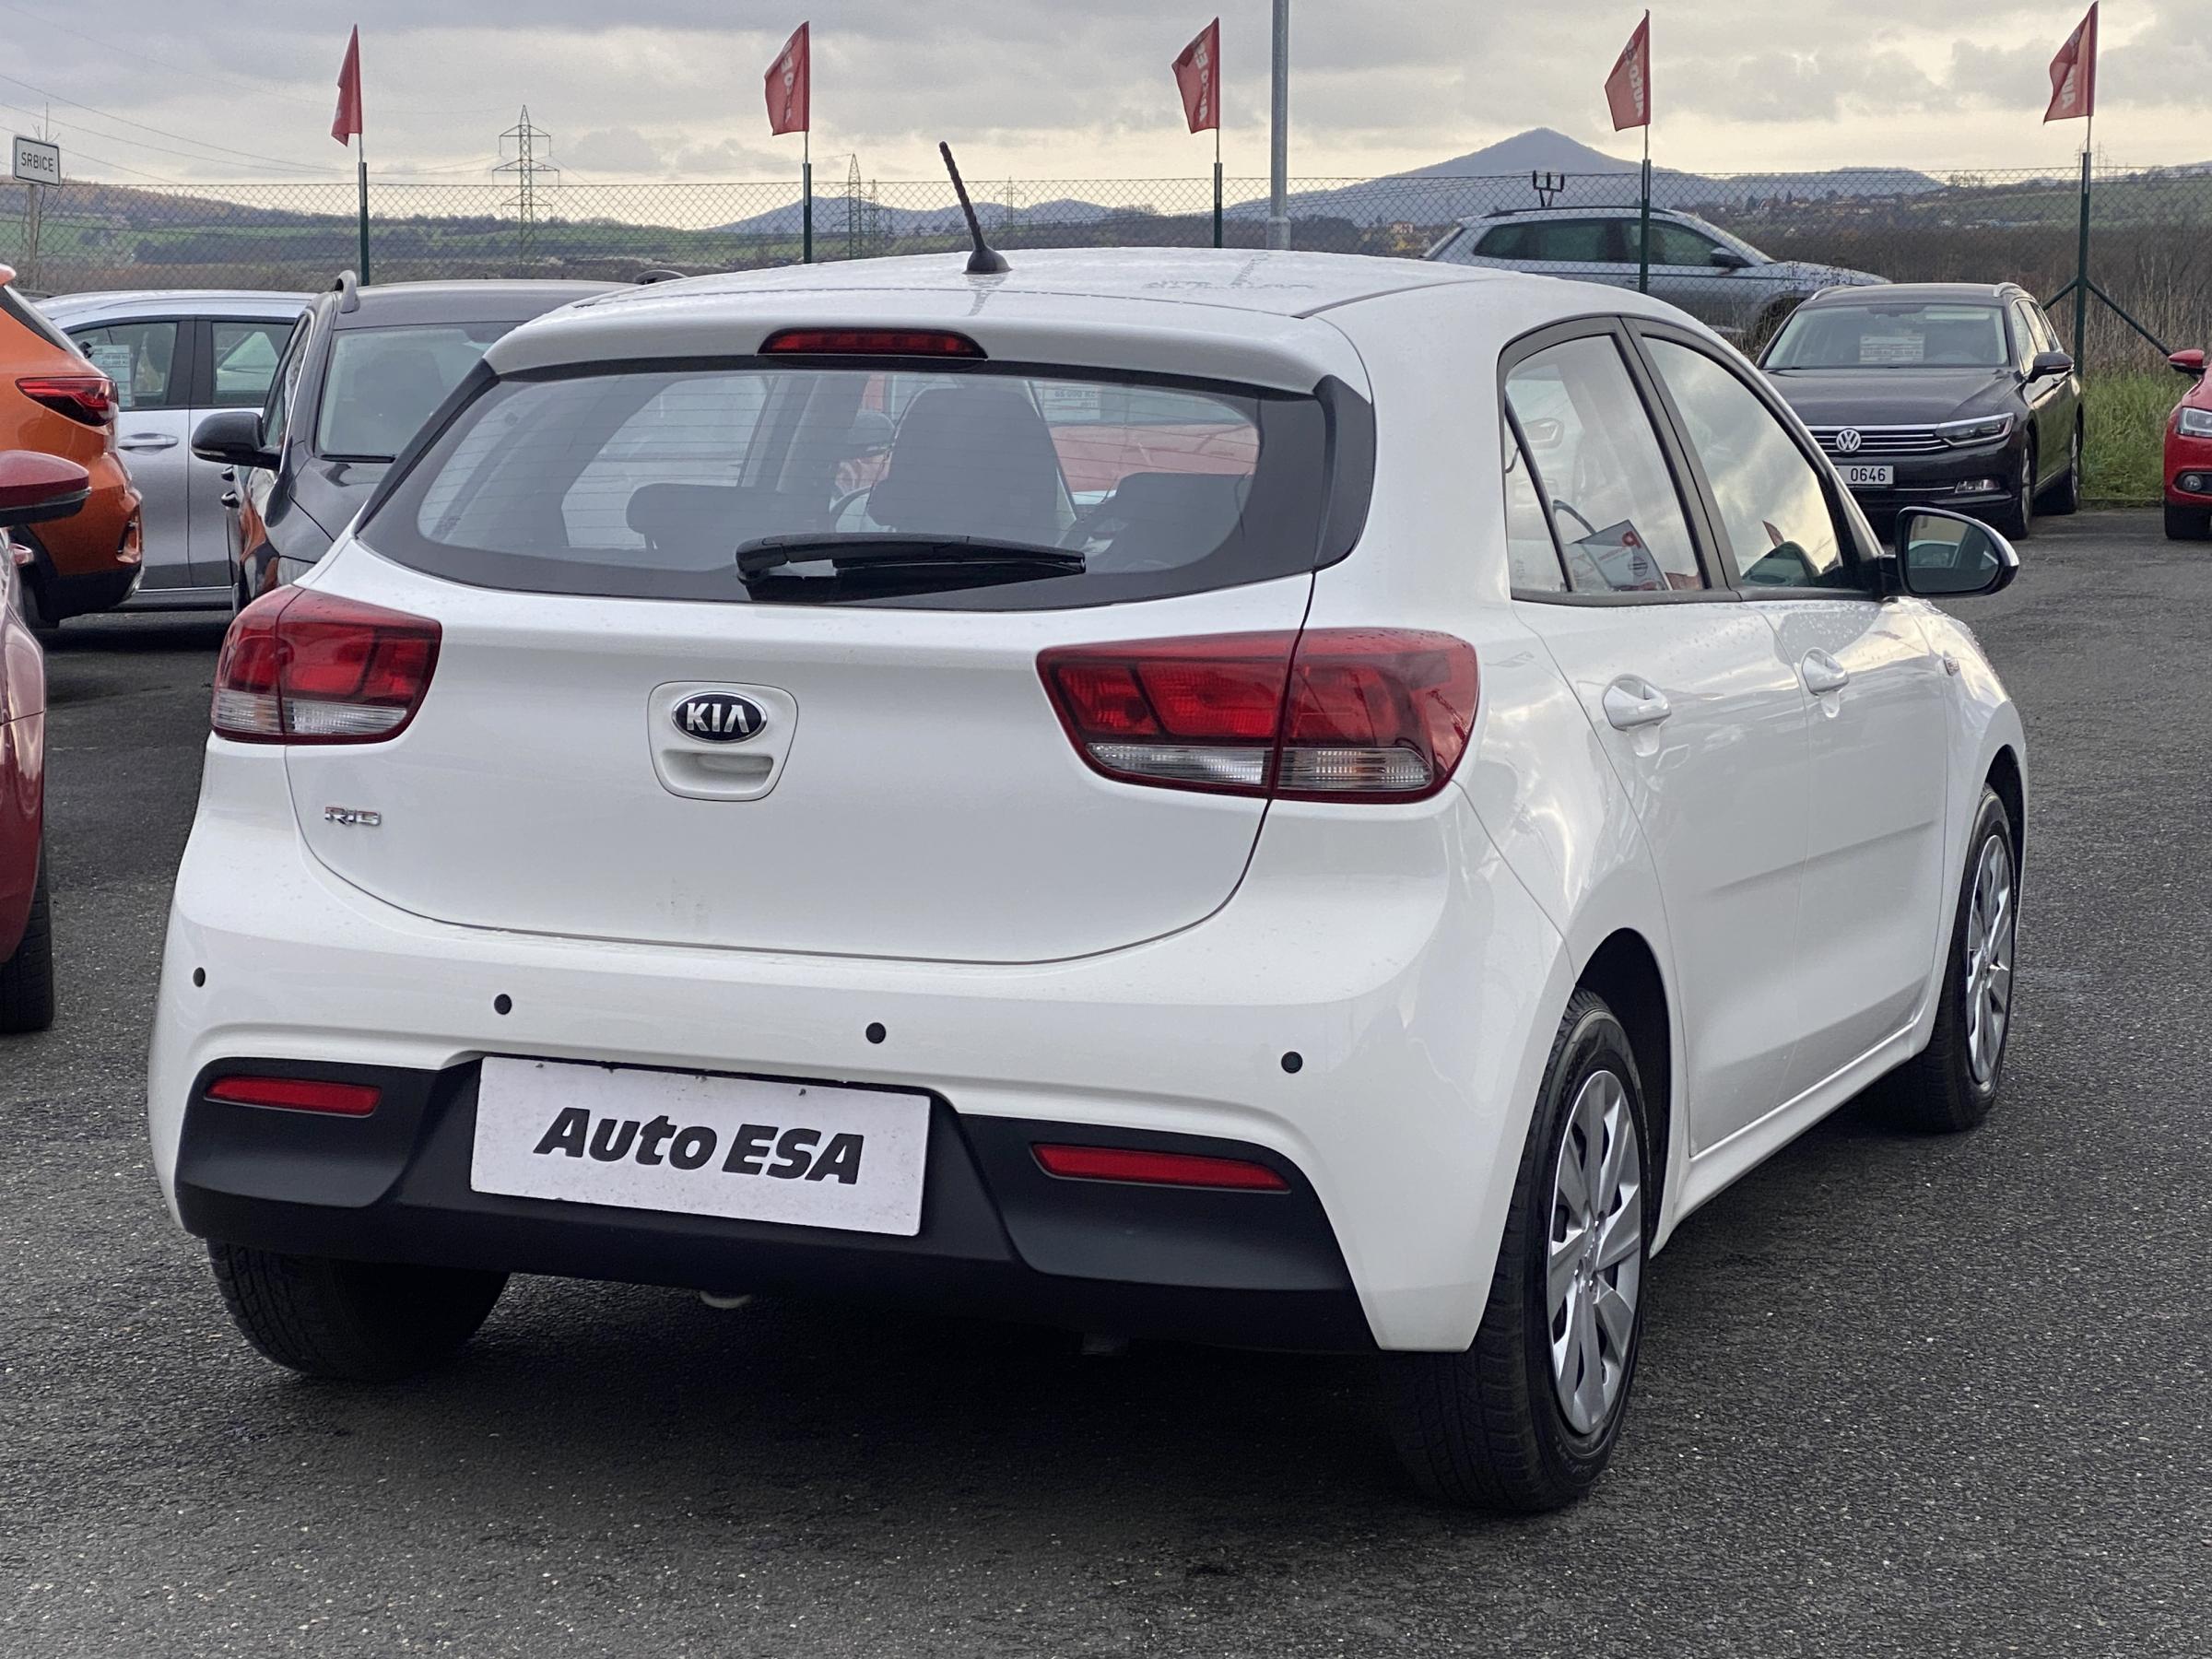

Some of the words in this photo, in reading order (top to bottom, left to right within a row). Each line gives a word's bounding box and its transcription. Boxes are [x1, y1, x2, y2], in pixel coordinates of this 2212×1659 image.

[21, 152, 53, 172] SRBICE
[1850, 467, 1886, 482] 0646
[686, 702, 749, 733] KIA
[324, 806, 382, 826] RIO
[533, 1107, 718, 1170] Auto
[722, 1124, 865, 1185] ESA
